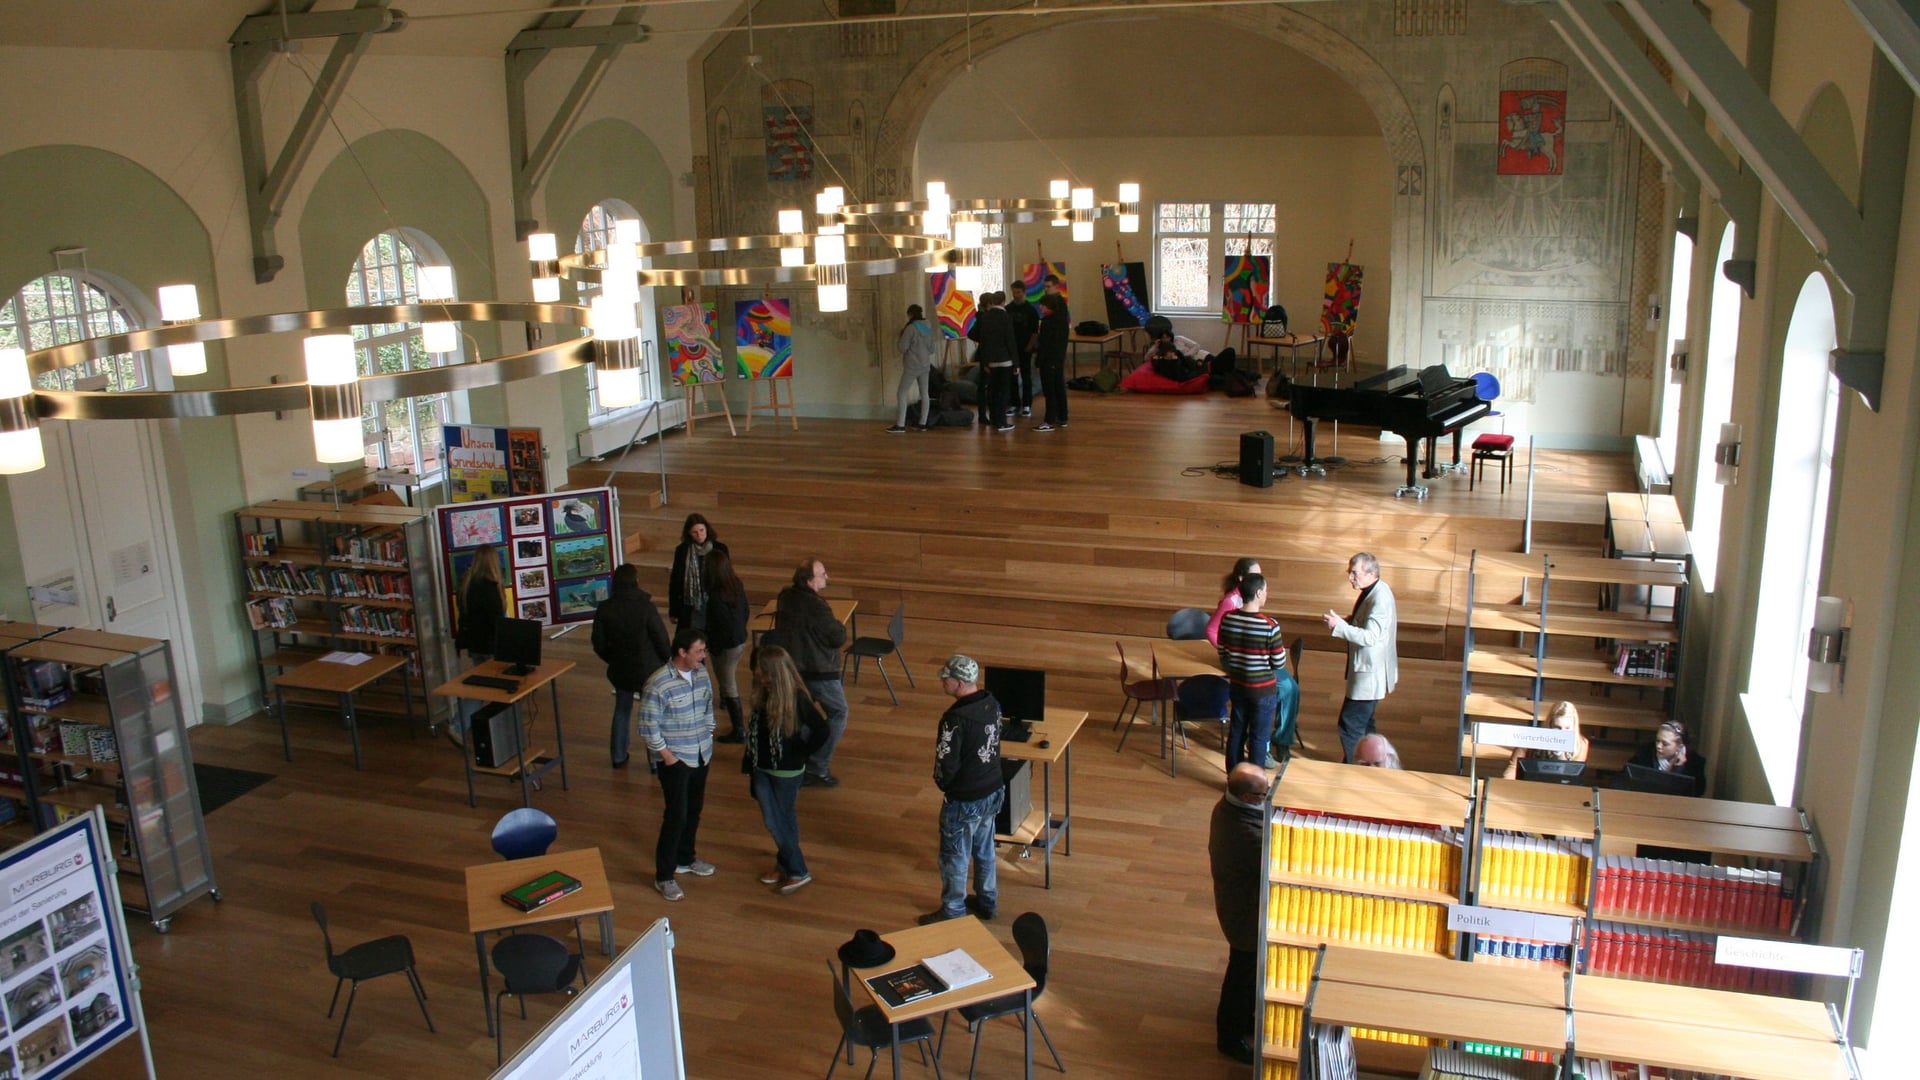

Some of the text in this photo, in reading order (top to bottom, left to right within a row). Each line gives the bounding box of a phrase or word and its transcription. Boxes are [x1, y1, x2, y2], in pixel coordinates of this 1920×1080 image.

[12, 857, 73, 895] MARBURG
[1456, 914, 1492, 926] Politik
[570, 1000, 620, 1054] MARBURG
